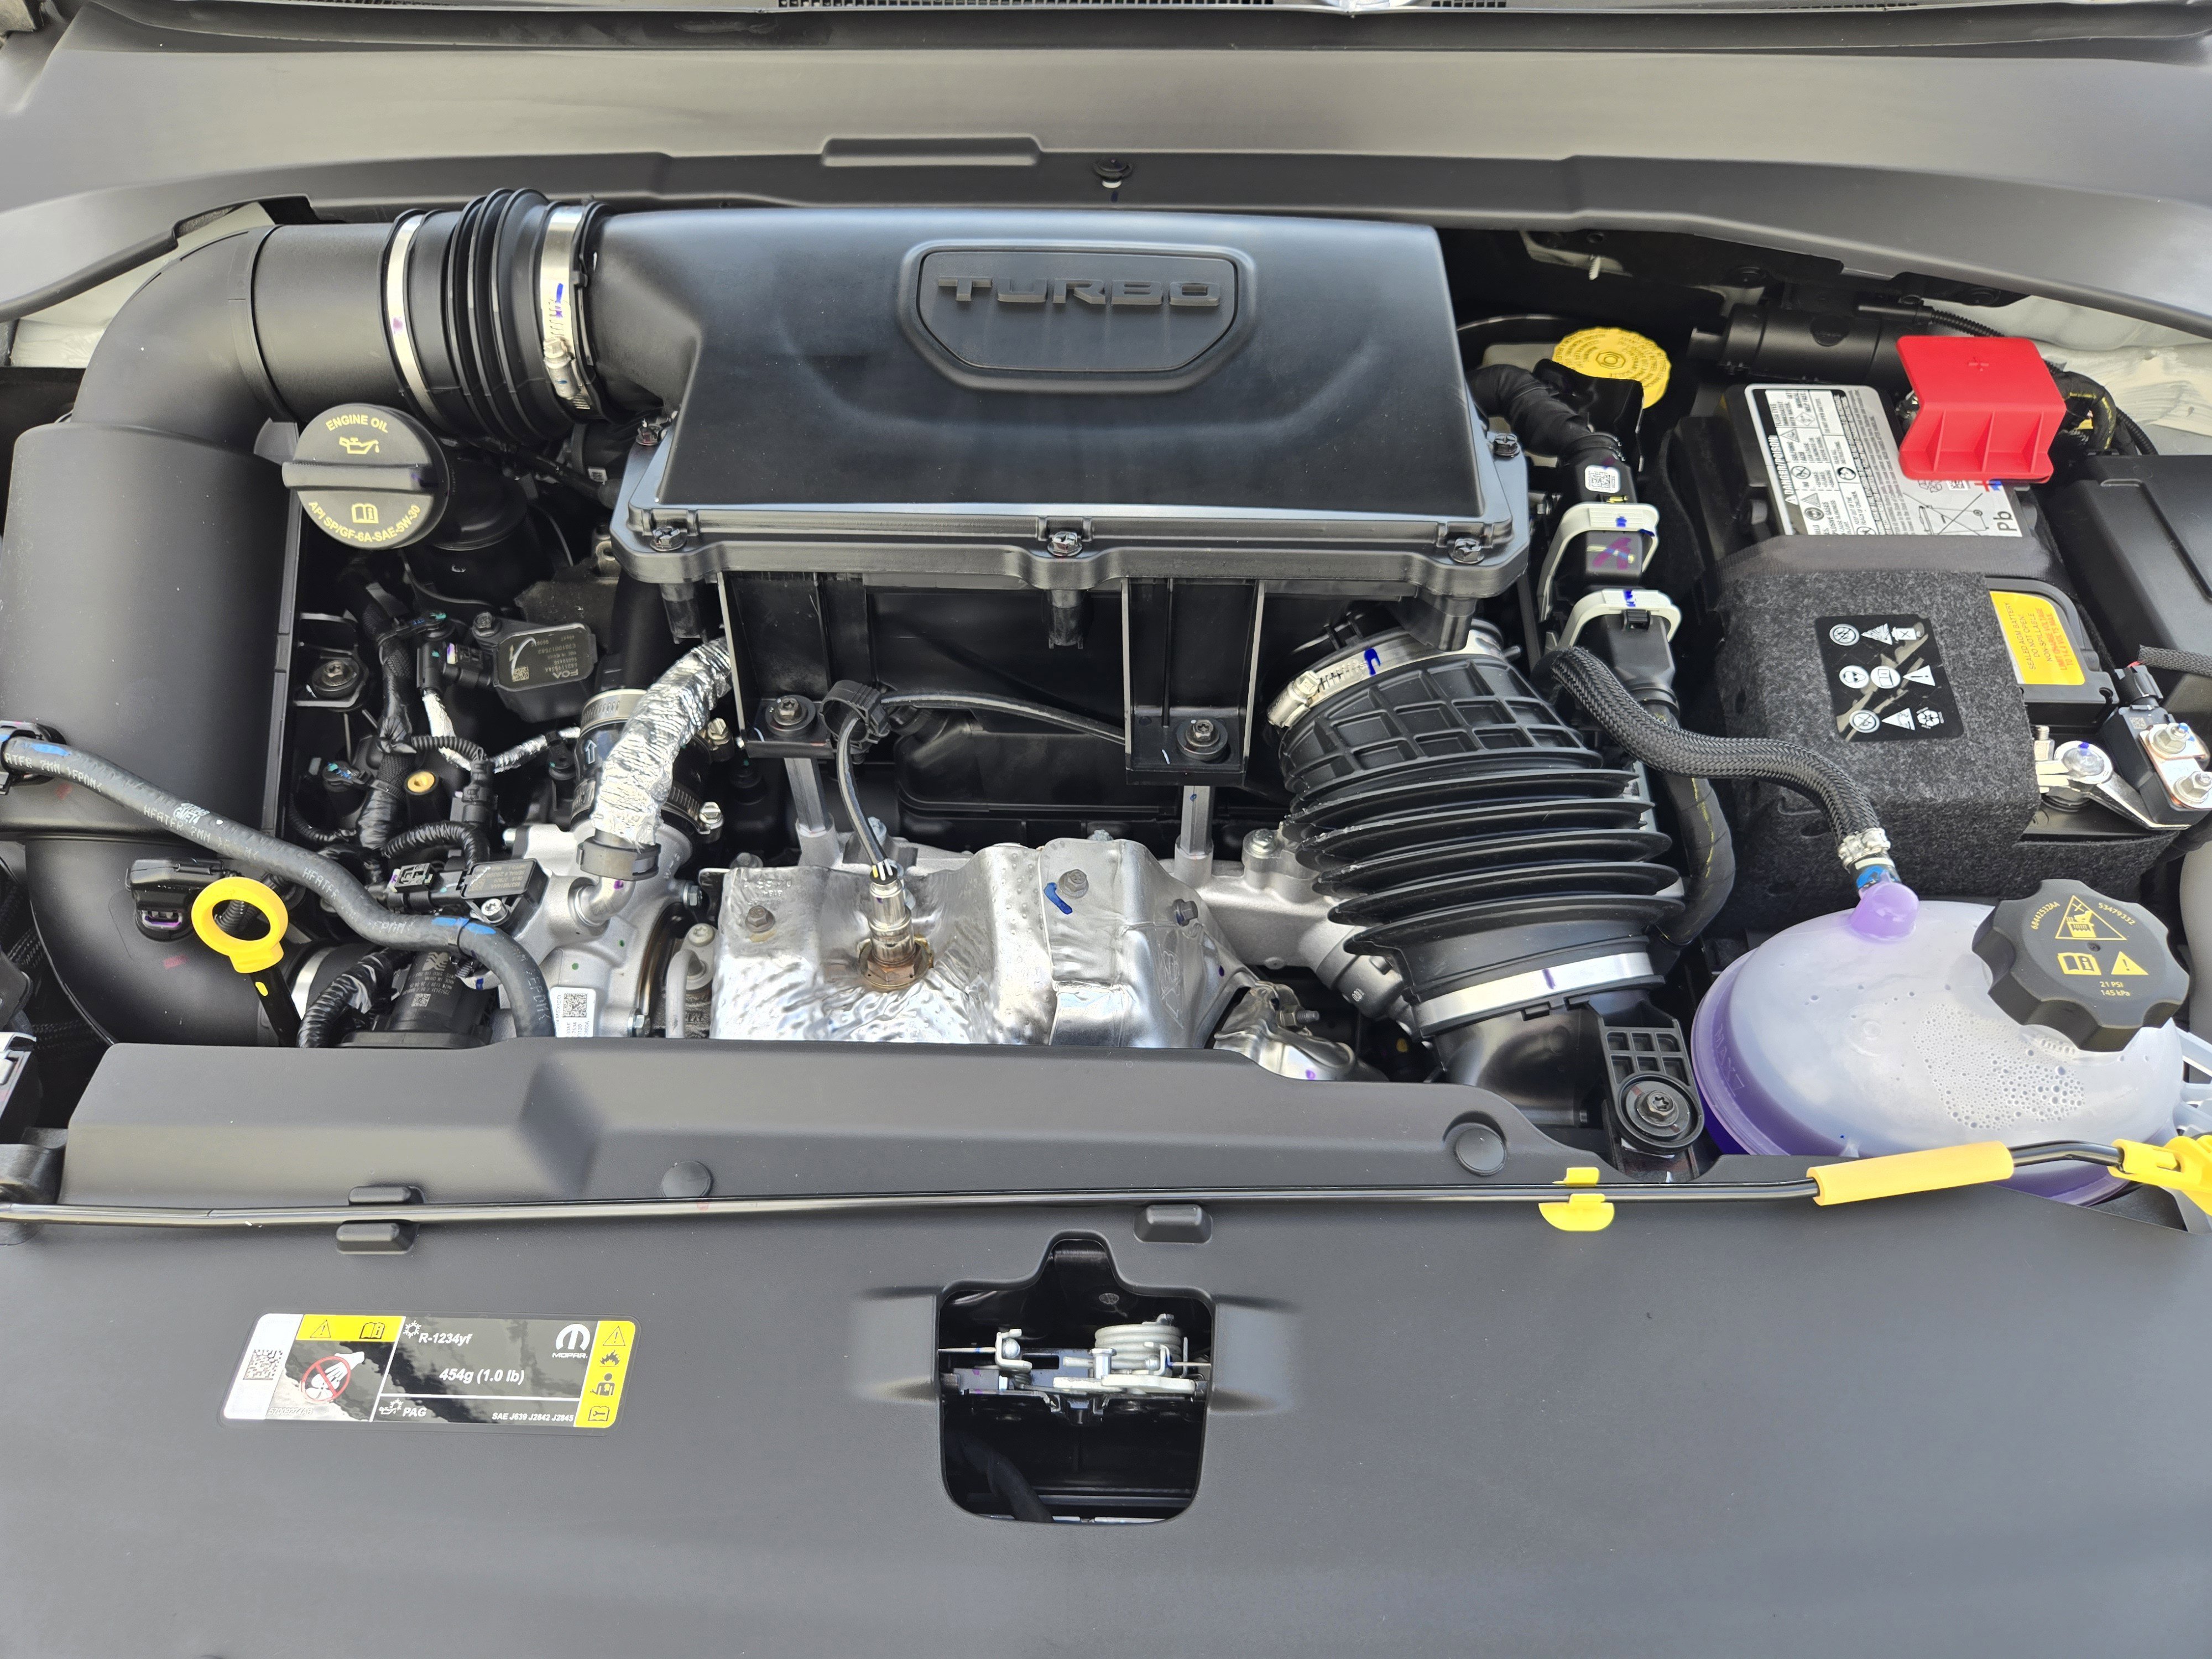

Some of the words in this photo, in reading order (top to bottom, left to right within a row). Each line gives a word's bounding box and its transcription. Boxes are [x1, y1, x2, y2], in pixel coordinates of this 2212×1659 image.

[938, 276, 1220, 307] TURBO
[326, 414, 368, 431] ENGINE
[371, 418, 388, 433] OIL
[1767, 436, 1795, 494] DANGER/POISON
[308, 501, 326, 520] API
[1993, 511, 2017, 531] Pb
[2004, 602, 2020, 628] BATTERY
[2034, 607, 2050, 630] VOLTAGE
[2014, 630, 2026, 644] AGM
[2025, 635, 2036, 647] NOT
[2027, 613, 2053, 661] NON-SPILLABLE
[2045, 632, 2060, 654] CHARGE
[2051, 628, 2065, 644] VOLTS
[2020, 645, 2036, 670] SEALED
[2031, 649, 2040, 657] DO
[2054, 655, 2068, 670] LIMIT
[2031, 901, 2060, 930] 68442532AA
[2098, 902, 2136, 926] 53479332
[1714, 1023, 1735, 1082] MAX
[419, 1333, 473, 1346] R-1234yf
[439, 1368, 474, 1384] 454g
[477, 1369, 503, 1384] (1.0
[505, 1369, 525, 1385] lb)
[403, 1407, 427, 1417] PAG
[492, 1412, 509, 1421] SAE
